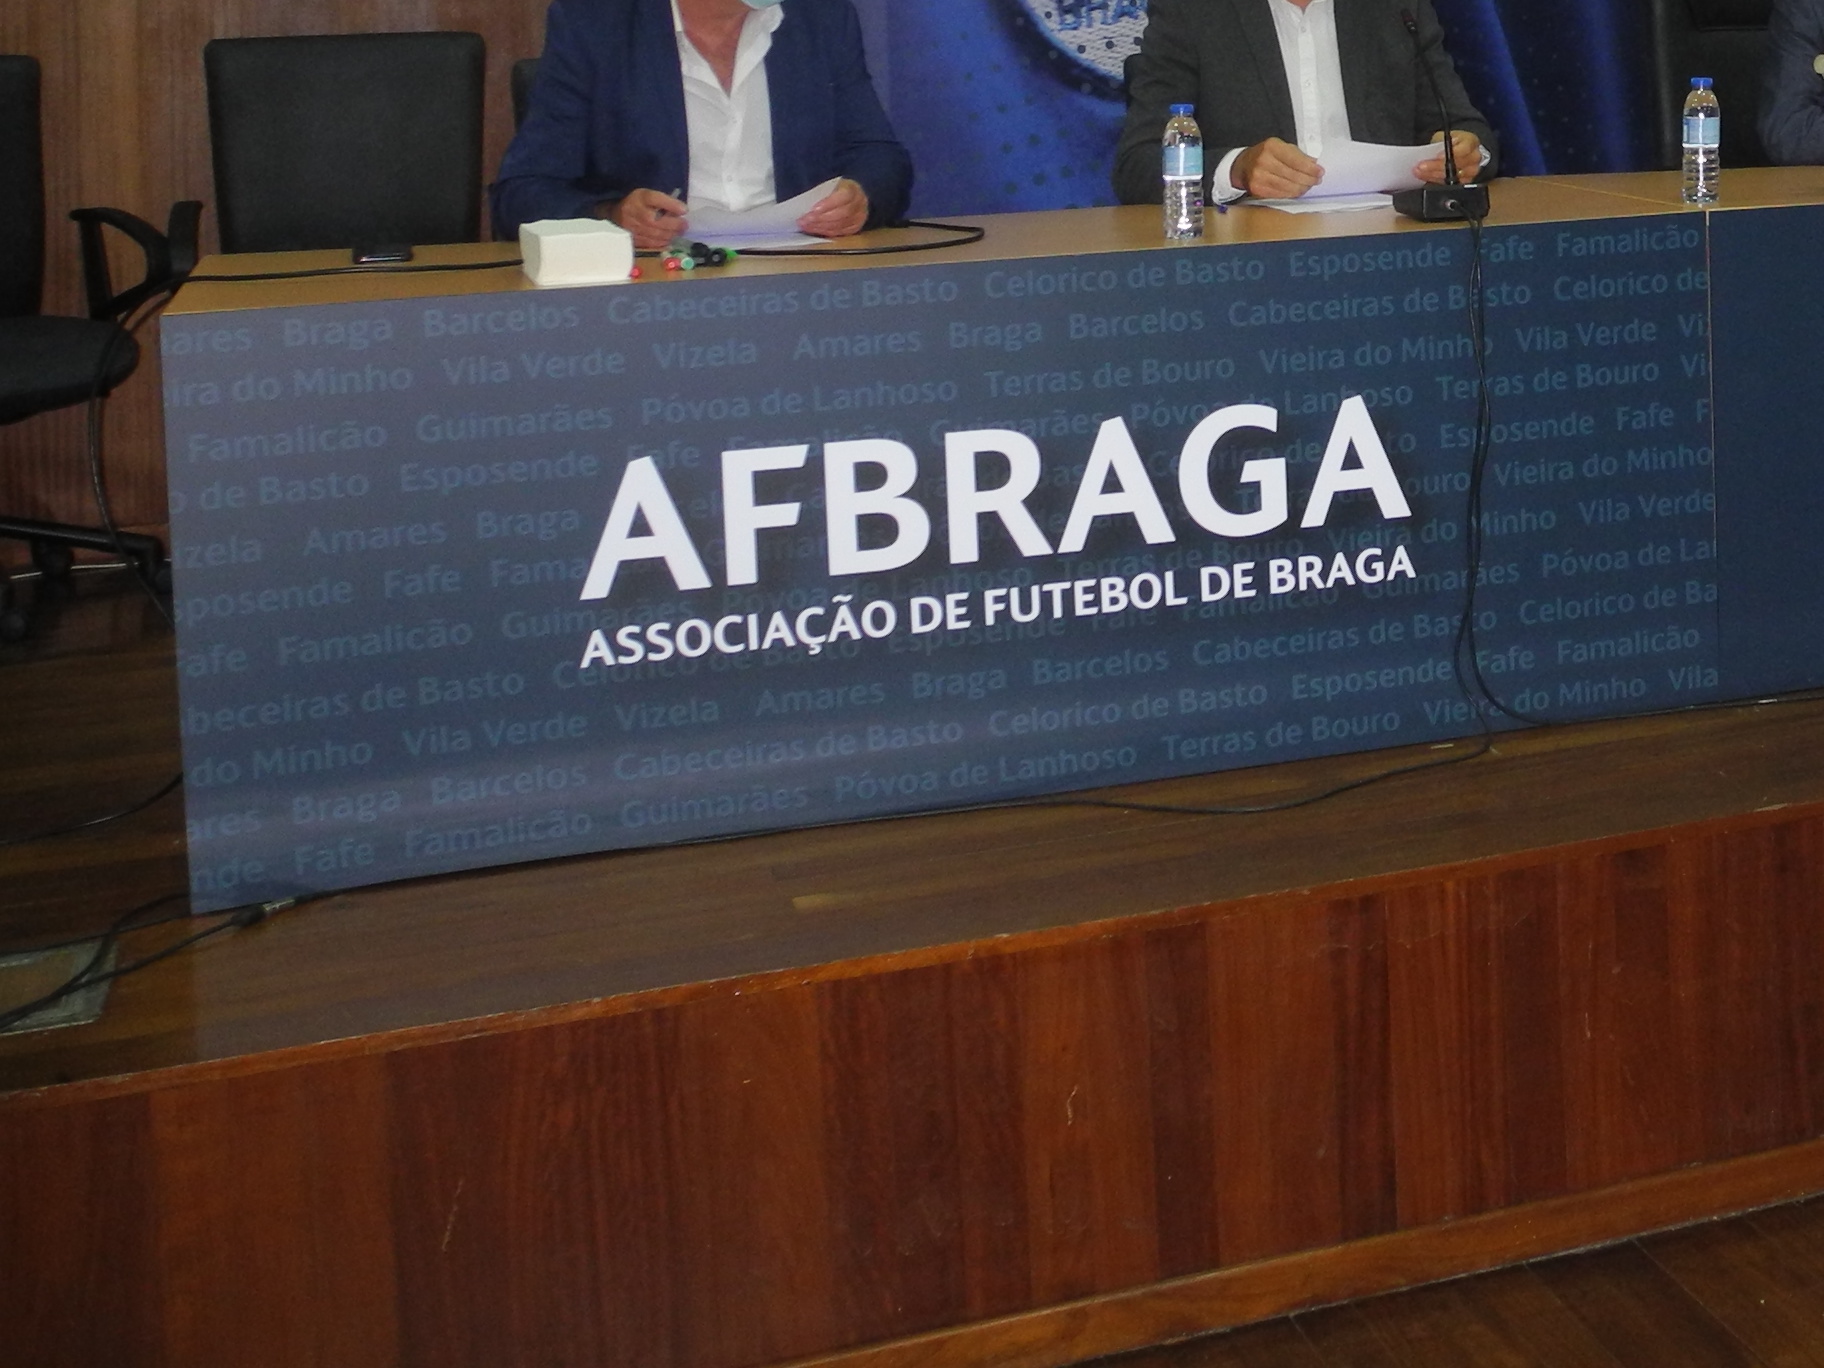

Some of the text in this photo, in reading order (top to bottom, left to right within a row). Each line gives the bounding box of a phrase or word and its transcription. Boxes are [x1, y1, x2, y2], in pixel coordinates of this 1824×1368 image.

[230, 372, 282, 403] do
[293, 362, 414, 398] Minho
[442, 355, 511, 386] Vila
[522, 346, 626, 380] Verde
[651, 336, 758, 370] Vizela
[791, 331, 922, 360] Amares
[949, 321, 1043, 351] Braga
[1068, 305, 1204, 338] Barcelos
[1228, 293, 1394, 326] Cabeceiras
[1404, 286, 1440, 313] de
[1553, 272, 1668, 301] Celorico
[282, 224, 1698, 351] Braga Barcelos Cabeceiras de Basto Celorico de Basto Esposende Famalicão
[187, 419, 388, 462] Famalicão
[415, 403, 614, 443] Guimarães
[640, 394, 751, 425] Póvoa
[760, 386, 803, 415] de
[814, 377, 958, 411] Lanhoso
[983, 370, 1083, 397] Terras
[1091, 360, 1131, 388] de
[1141, 358, 1235, 383] Bouro
[1259, 346, 1345, 374] Vieira
[1353, 339, 1391, 366] do
[1515, 325, 1568, 352] Vila
[1577, 318, 1656, 347] Verde
[197, 476, 247, 508] de
[257, 471, 370, 503] Basto
[399, 447, 599, 495] Esposende
[1533, 367, 1568, 393] de
[1576, 365, 1660, 389] Bouro
[302, 521, 447, 555] Amares
[475, 509, 580, 541] Braga
[1615, 403, 1674, 431] Fafe
[383, 564, 462, 598] Fafe
[1494, 458, 1574, 486] Vieira
[1582, 451, 1618, 477] do
[580, 394, 1412, 601] AFBRAGA
[278, 618, 472, 664] Famalicão
[1421, 515, 1457, 541] do
[1579, 497, 1629, 524] Vila
[359, 681, 406, 712] de
[418, 672, 524, 705] Basto
[1542, 549, 1630, 578] Póvoa
[1637, 541, 1672, 567] de
[579, 595, 898, 669] ASSOCIAÇÃO
[910, 592, 972, 635] DE
[984, 570, 1188, 626] FUTEBOL
[1201, 562, 1257, 603] DE
[1268, 544, 1417, 594] BRAGA
[189, 752, 239, 784] do
[252, 736, 373, 777] Minho
[402, 725, 472, 759] Vila
[484, 711, 588, 749] Verde
[615, 696, 720, 733] Vizela
[754, 682, 885, 716] Amares
[912, 668, 1006, 699] Braga
[1032, 645, 1169, 683] Barcelos
[1192, 626, 1359, 664] Cabeceiras
[1368, 615, 1404, 643] de
[1519, 592, 1634, 624] Celorico
[1643, 584, 1677, 610] de
[291, 789, 401, 824] Braga
[430, 764, 586, 806] Barcelos
[614, 739, 805, 783] Cabeceiras
[815, 728, 856, 757] de
[867, 719, 964, 751] Basto
[988, 700, 1121, 735] Celorico
[1131, 689, 1169, 717] de
[1179, 681, 1267, 711] Basto
[1291, 654, 1451, 700] Esposende
[1557, 624, 1699, 663] Famalicão
[294, 838, 374, 874] Fafe
[404, 810, 591, 859] Famalicão
[620, 785, 808, 831] Guimarães
[834, 770, 940, 802] Póvoa
[949, 758, 989, 787] de
[999, 745, 1136, 781] Lanhoso
[1161, 729, 1256, 759] Terras
[1265, 718, 1302, 746] de
[1312, 711, 1400, 740] Bouro
[1514, 686, 1550, 713] do
[1558, 674, 1646, 707] Minho
